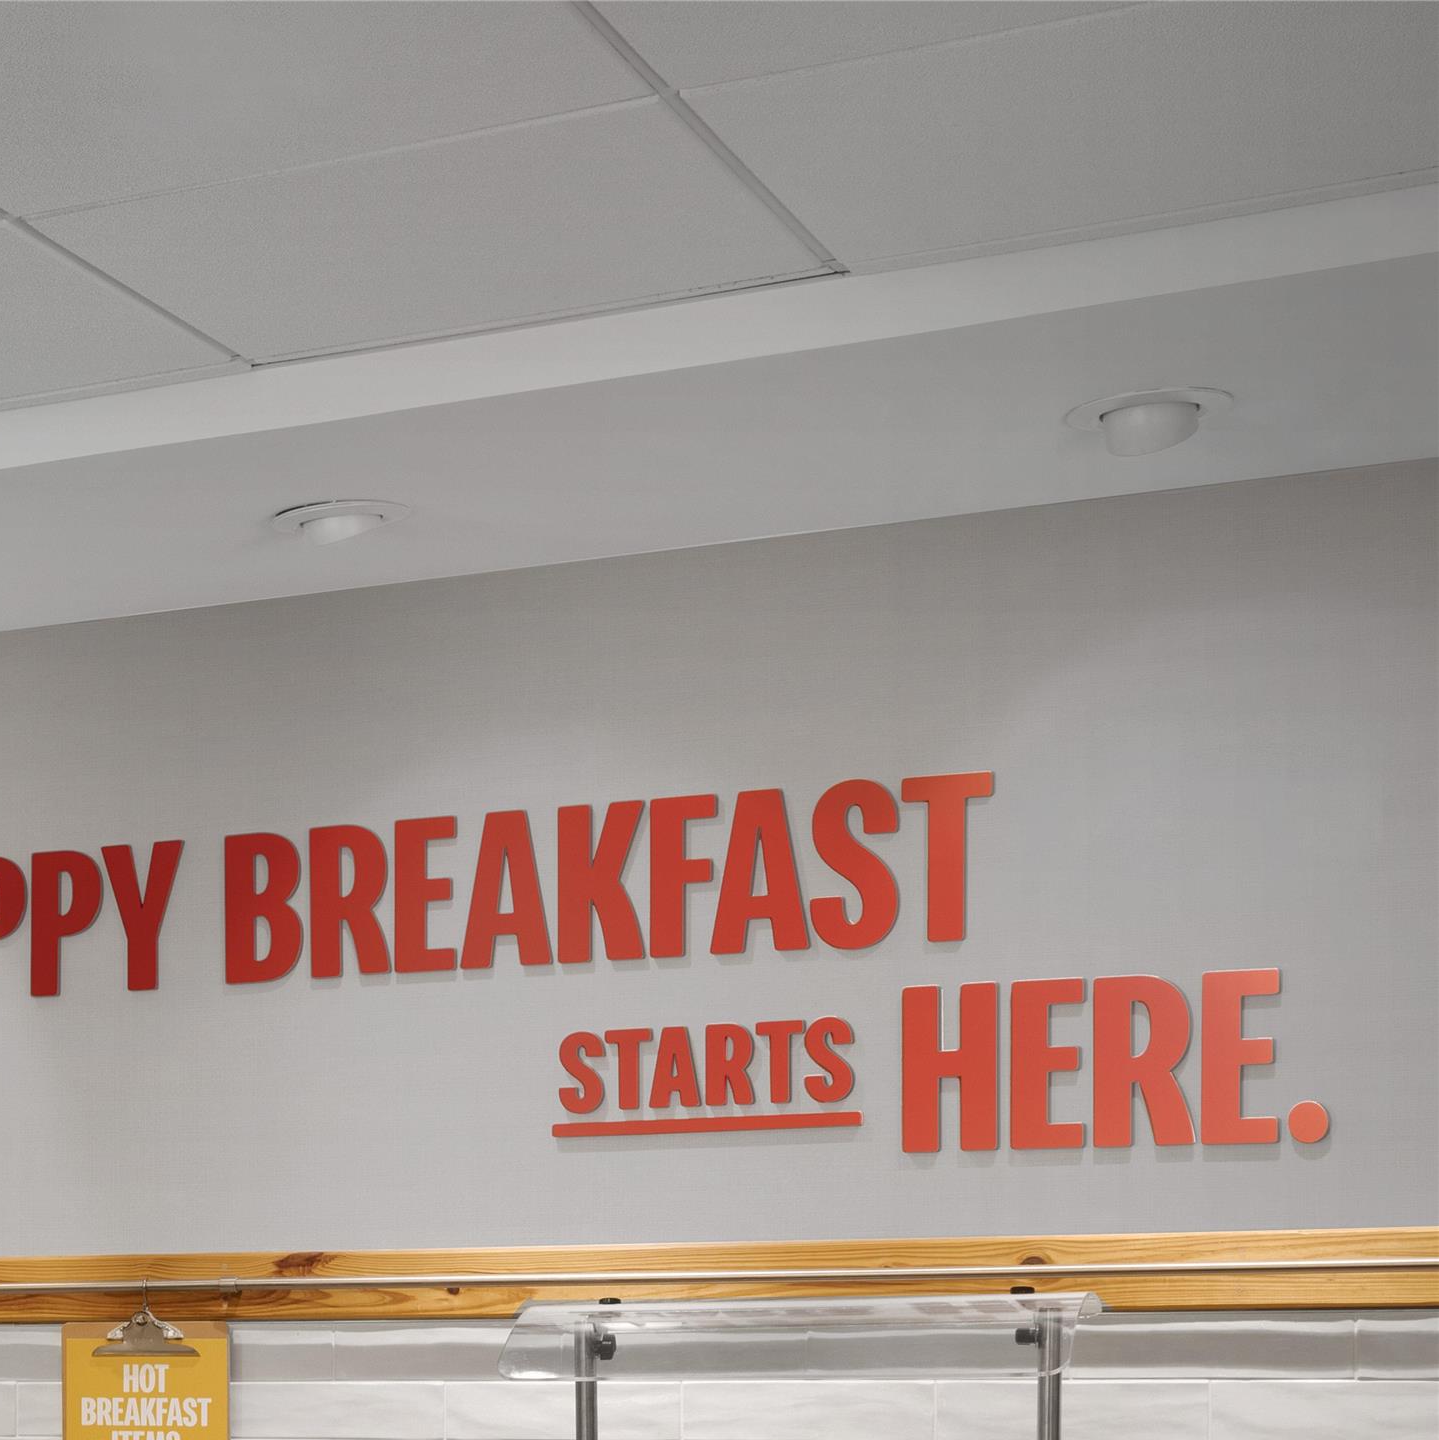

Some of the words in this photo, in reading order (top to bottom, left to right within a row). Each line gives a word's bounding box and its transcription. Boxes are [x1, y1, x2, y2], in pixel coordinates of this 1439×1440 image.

[224, 771, 995, 985] BREAKFAST
[558, 1016, 856, 1115] STARTS
[901, 967, 1330, 1153] HERE.
[81, 1397, 212, 1428] BREAKFAST
[123, 1363, 169, 1393] HOT
